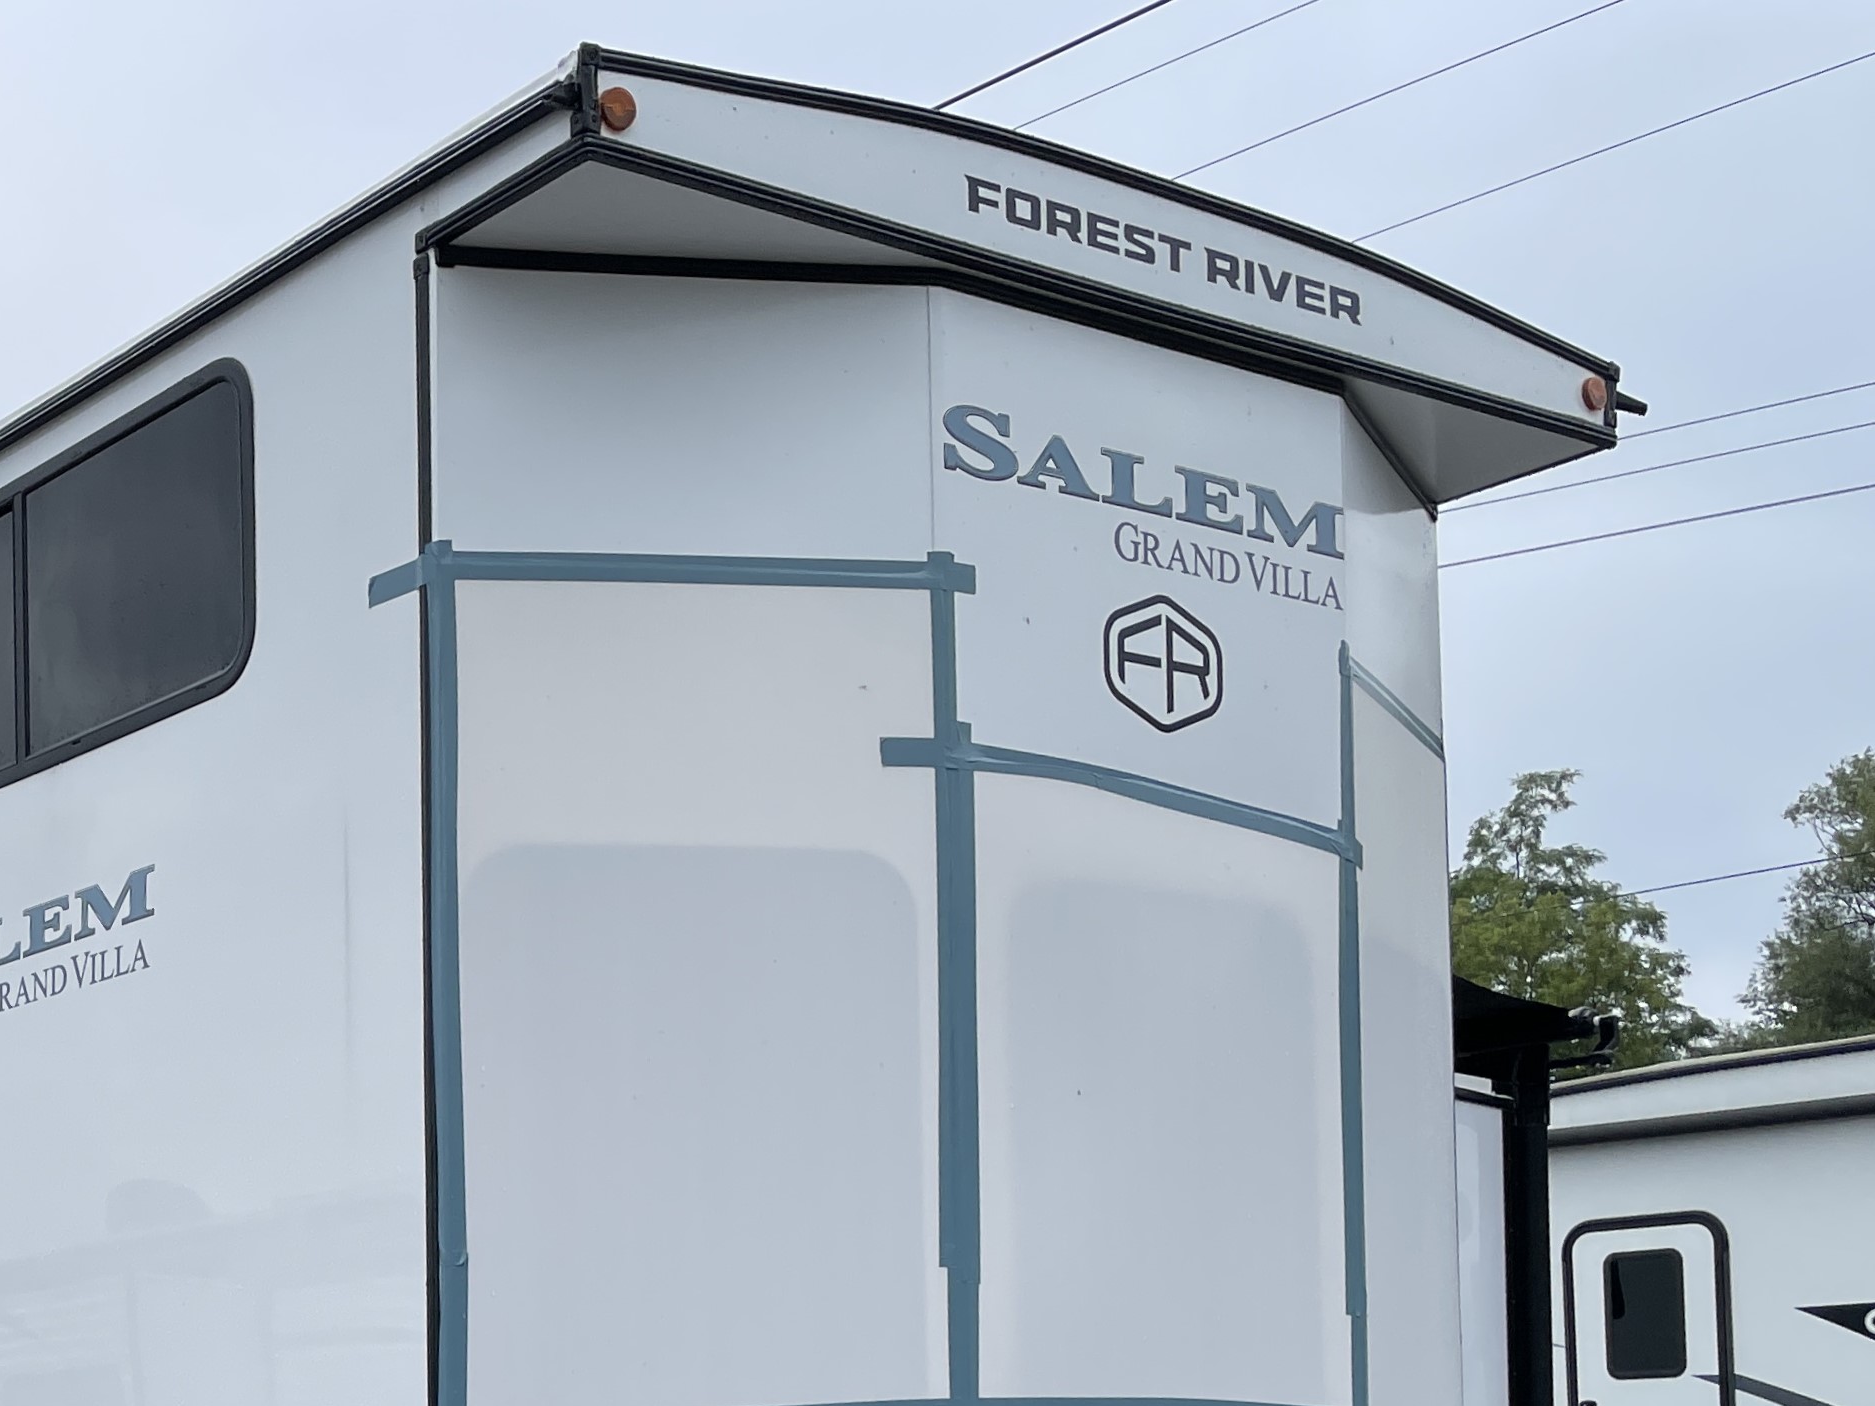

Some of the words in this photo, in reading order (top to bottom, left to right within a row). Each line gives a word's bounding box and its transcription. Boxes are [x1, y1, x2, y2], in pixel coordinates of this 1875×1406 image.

[964, 174, 1192, 273] FOREST
[1204, 246, 1362, 326] RIVER
[943, 404, 1345, 560] SALEM
[1114, 521, 1241, 584] GRAND
[1245, 551, 1344, 611] VILLA
[71, 938, 151, 989] VILLA
